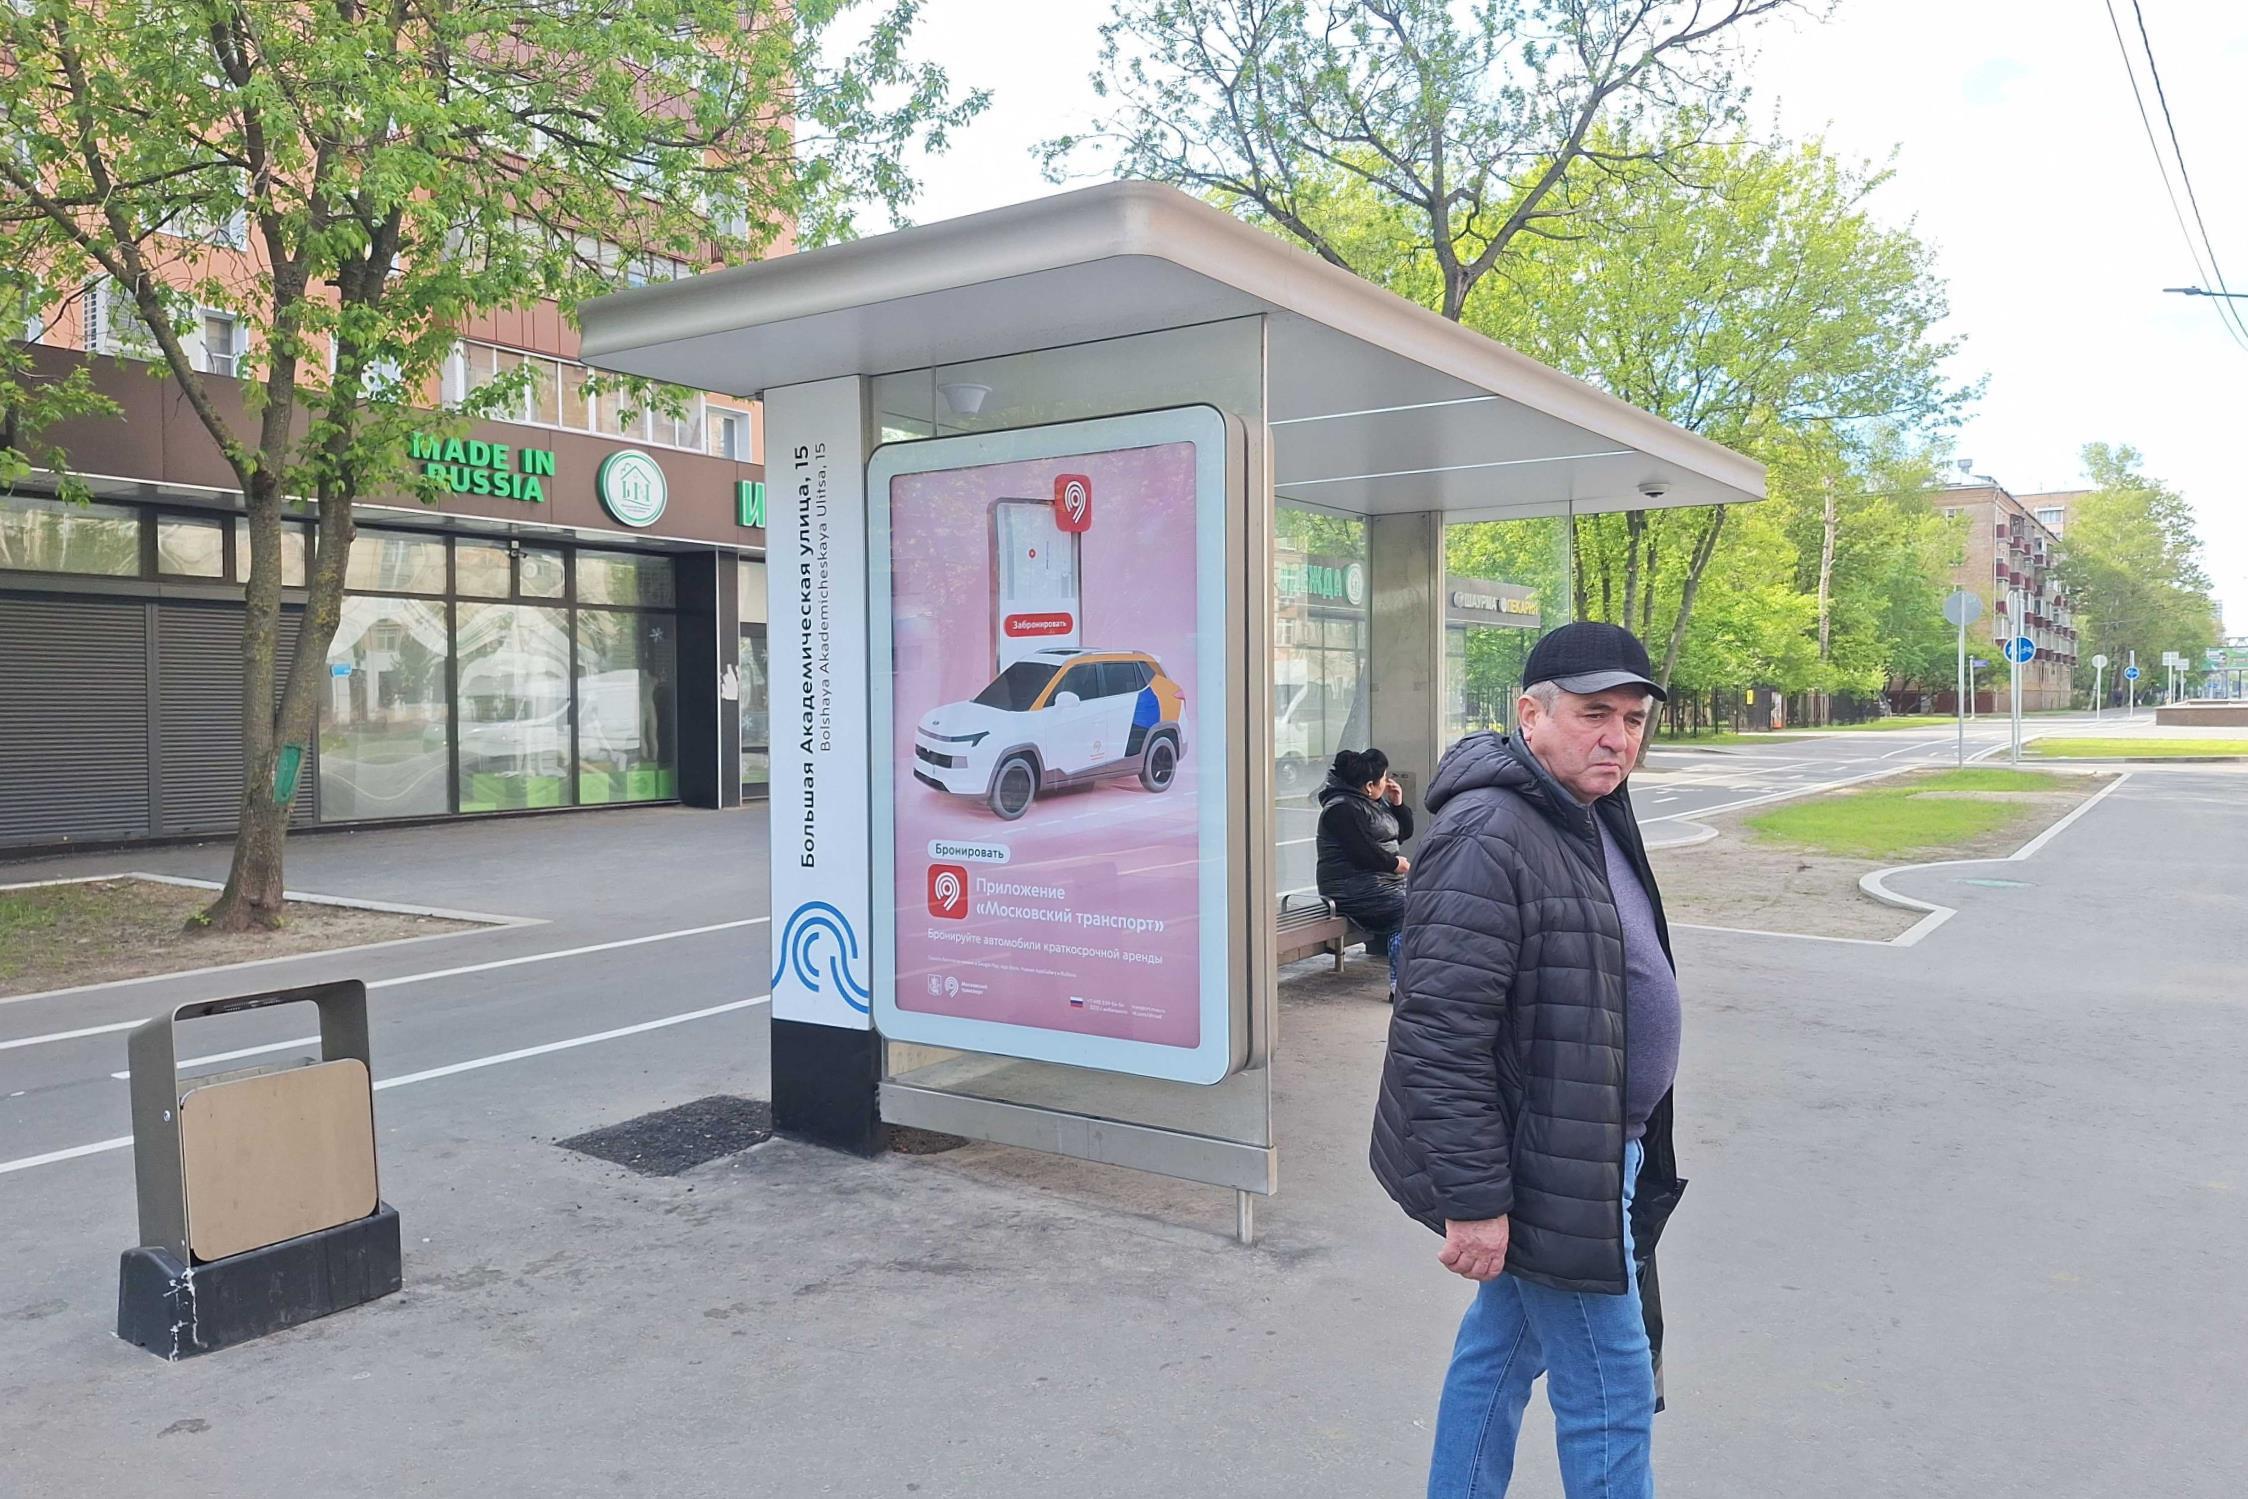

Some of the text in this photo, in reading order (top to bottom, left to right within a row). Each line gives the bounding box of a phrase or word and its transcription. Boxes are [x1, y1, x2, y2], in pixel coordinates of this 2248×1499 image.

[411, 431, 555, 476] MADE IN
[426, 463, 545, 503] RUSSIA
[814, 442, 832, 751] Bolshaya Akademicheskaya Ulitsa, 15
[1464, 592, 1498, 611] ШАУРМА
[1012, 620, 1067, 630] Забронировать
[794, 445, 815, 868] Большая Академическая улица, 15
[935, 843, 1004, 859] Бронировать
[976, 878, 1065, 900] Приложение
[976, 901, 1165, 933] «Московский транспорт»
[928, 928, 1163, 964] Бронируйте автомобили краткосрочной аренды
